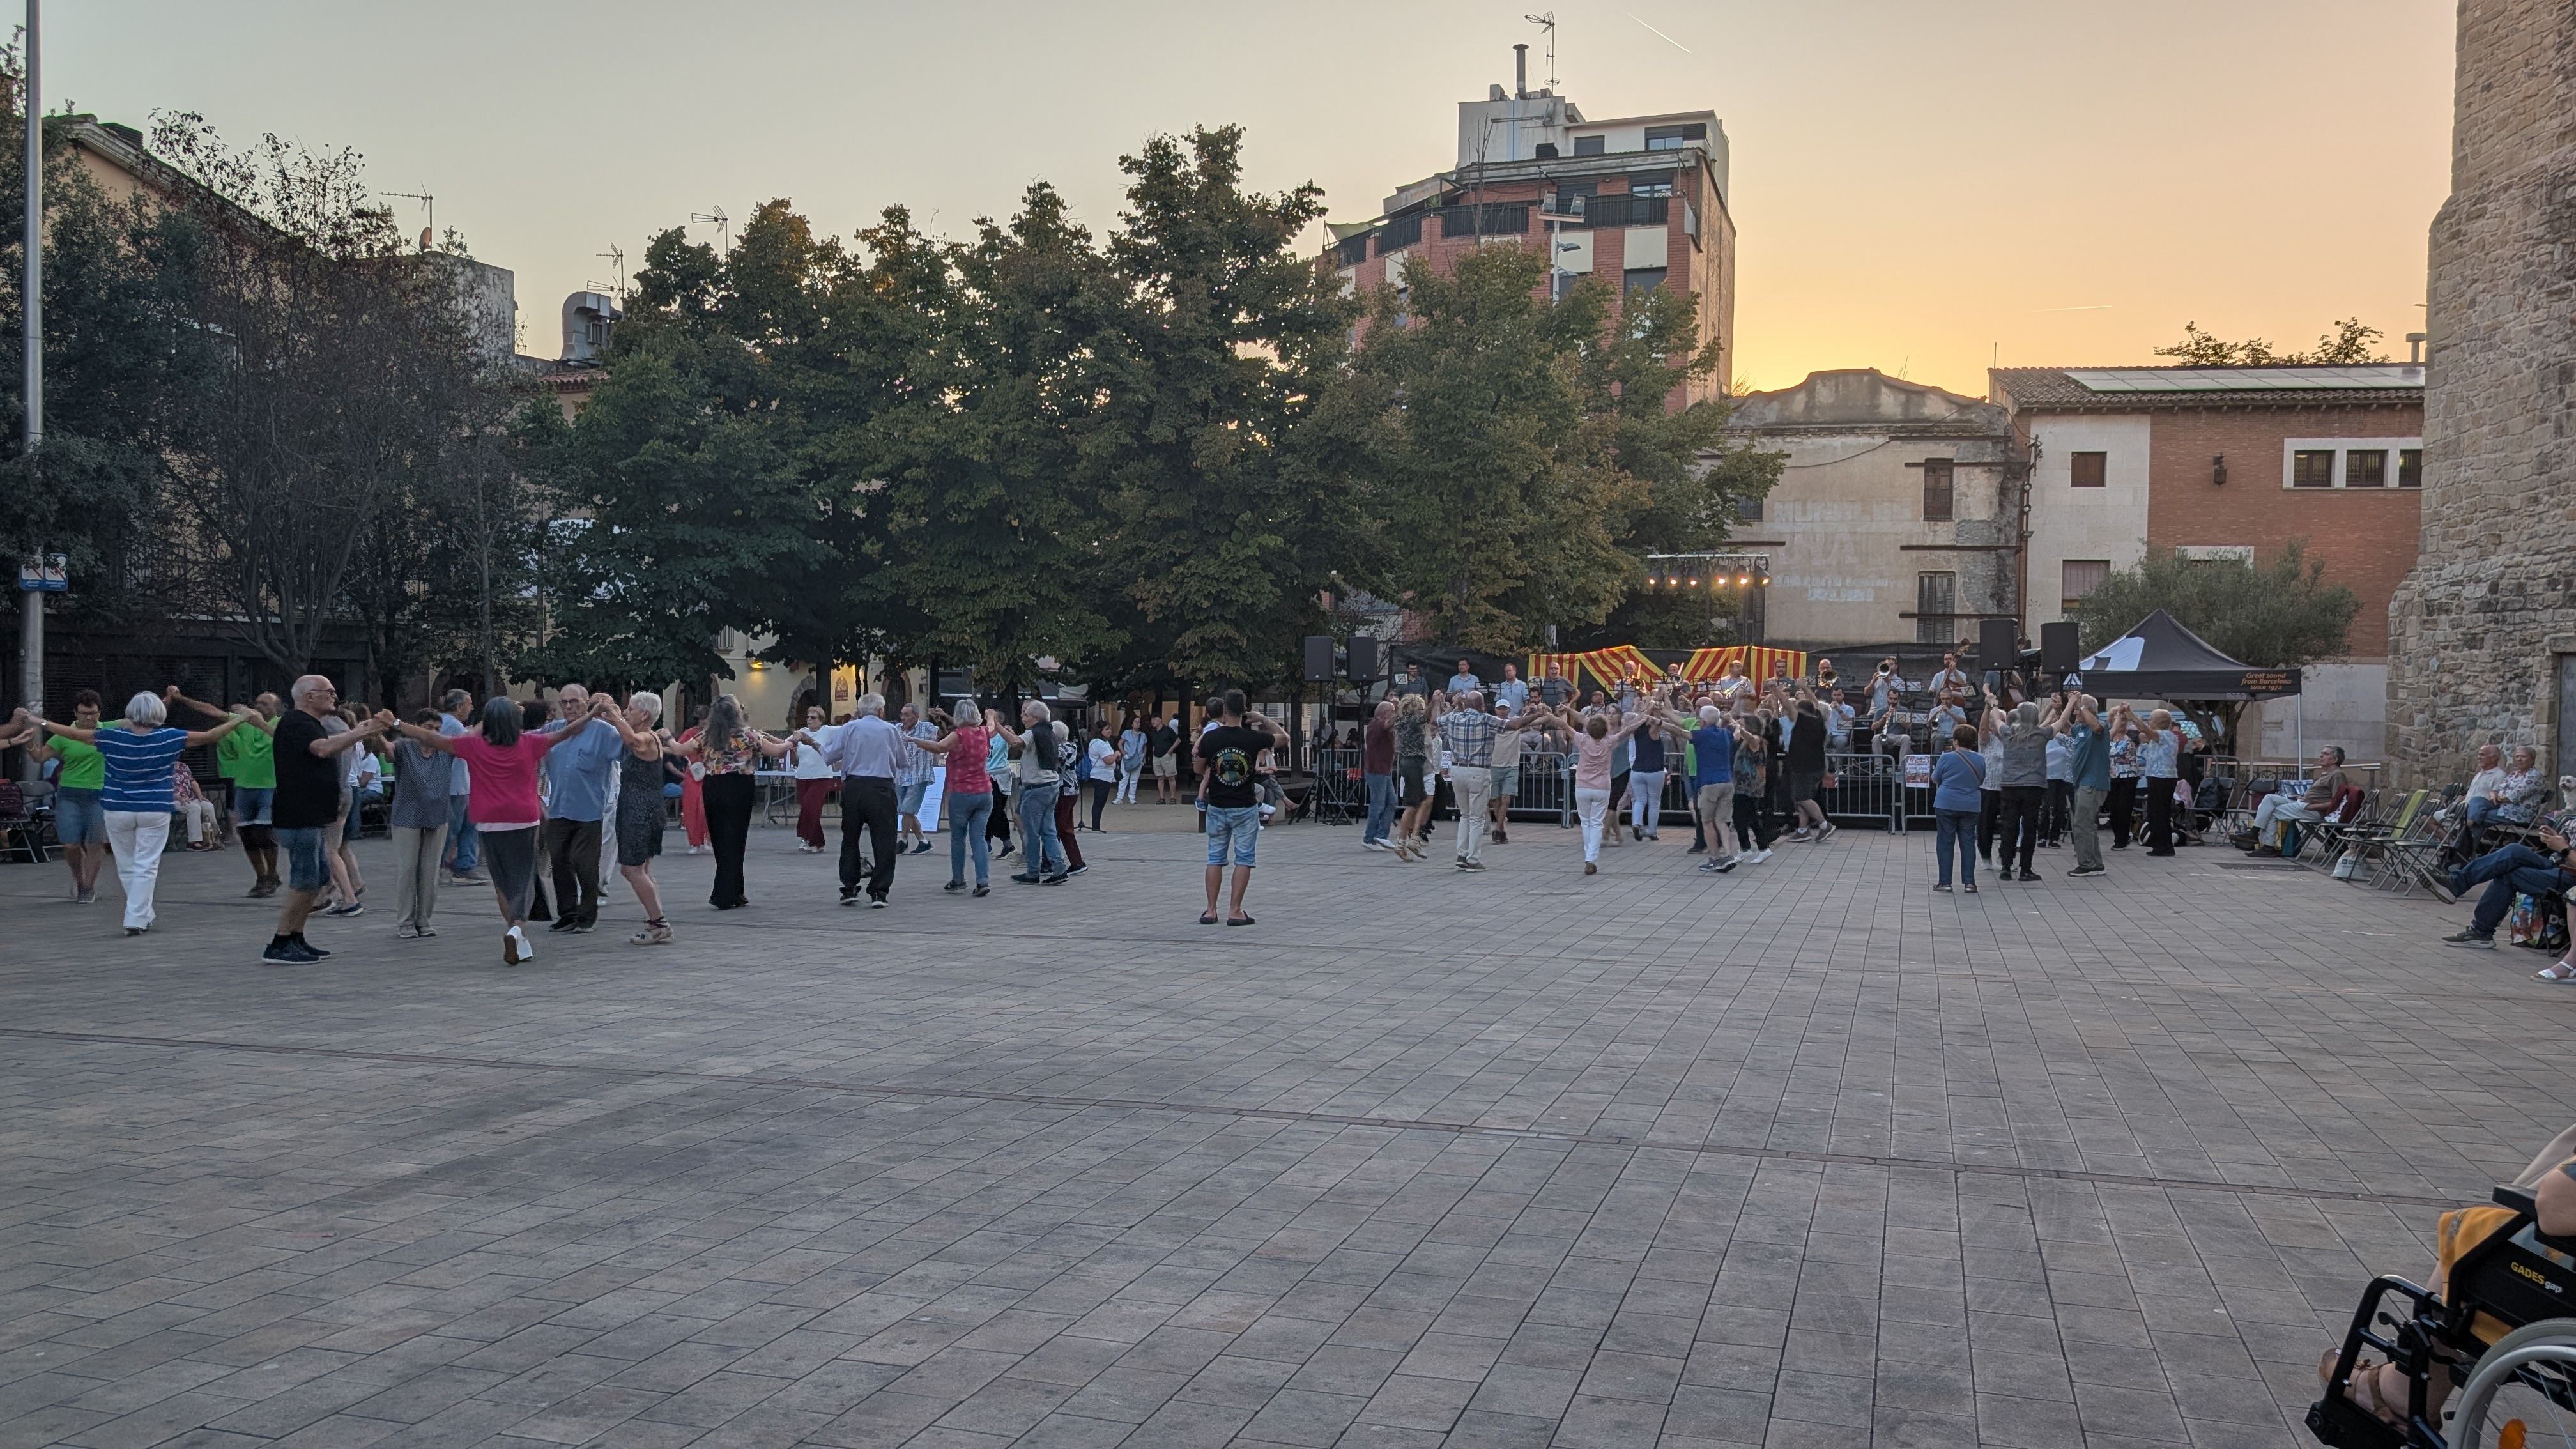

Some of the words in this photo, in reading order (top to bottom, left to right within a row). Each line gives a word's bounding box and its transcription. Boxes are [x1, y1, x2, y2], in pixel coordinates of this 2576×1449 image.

[1216, 749, 1231, 757] NIVEL
[2511, 1262, 2545, 1285] GADES
[2544, 1280, 2563, 1294] gap
